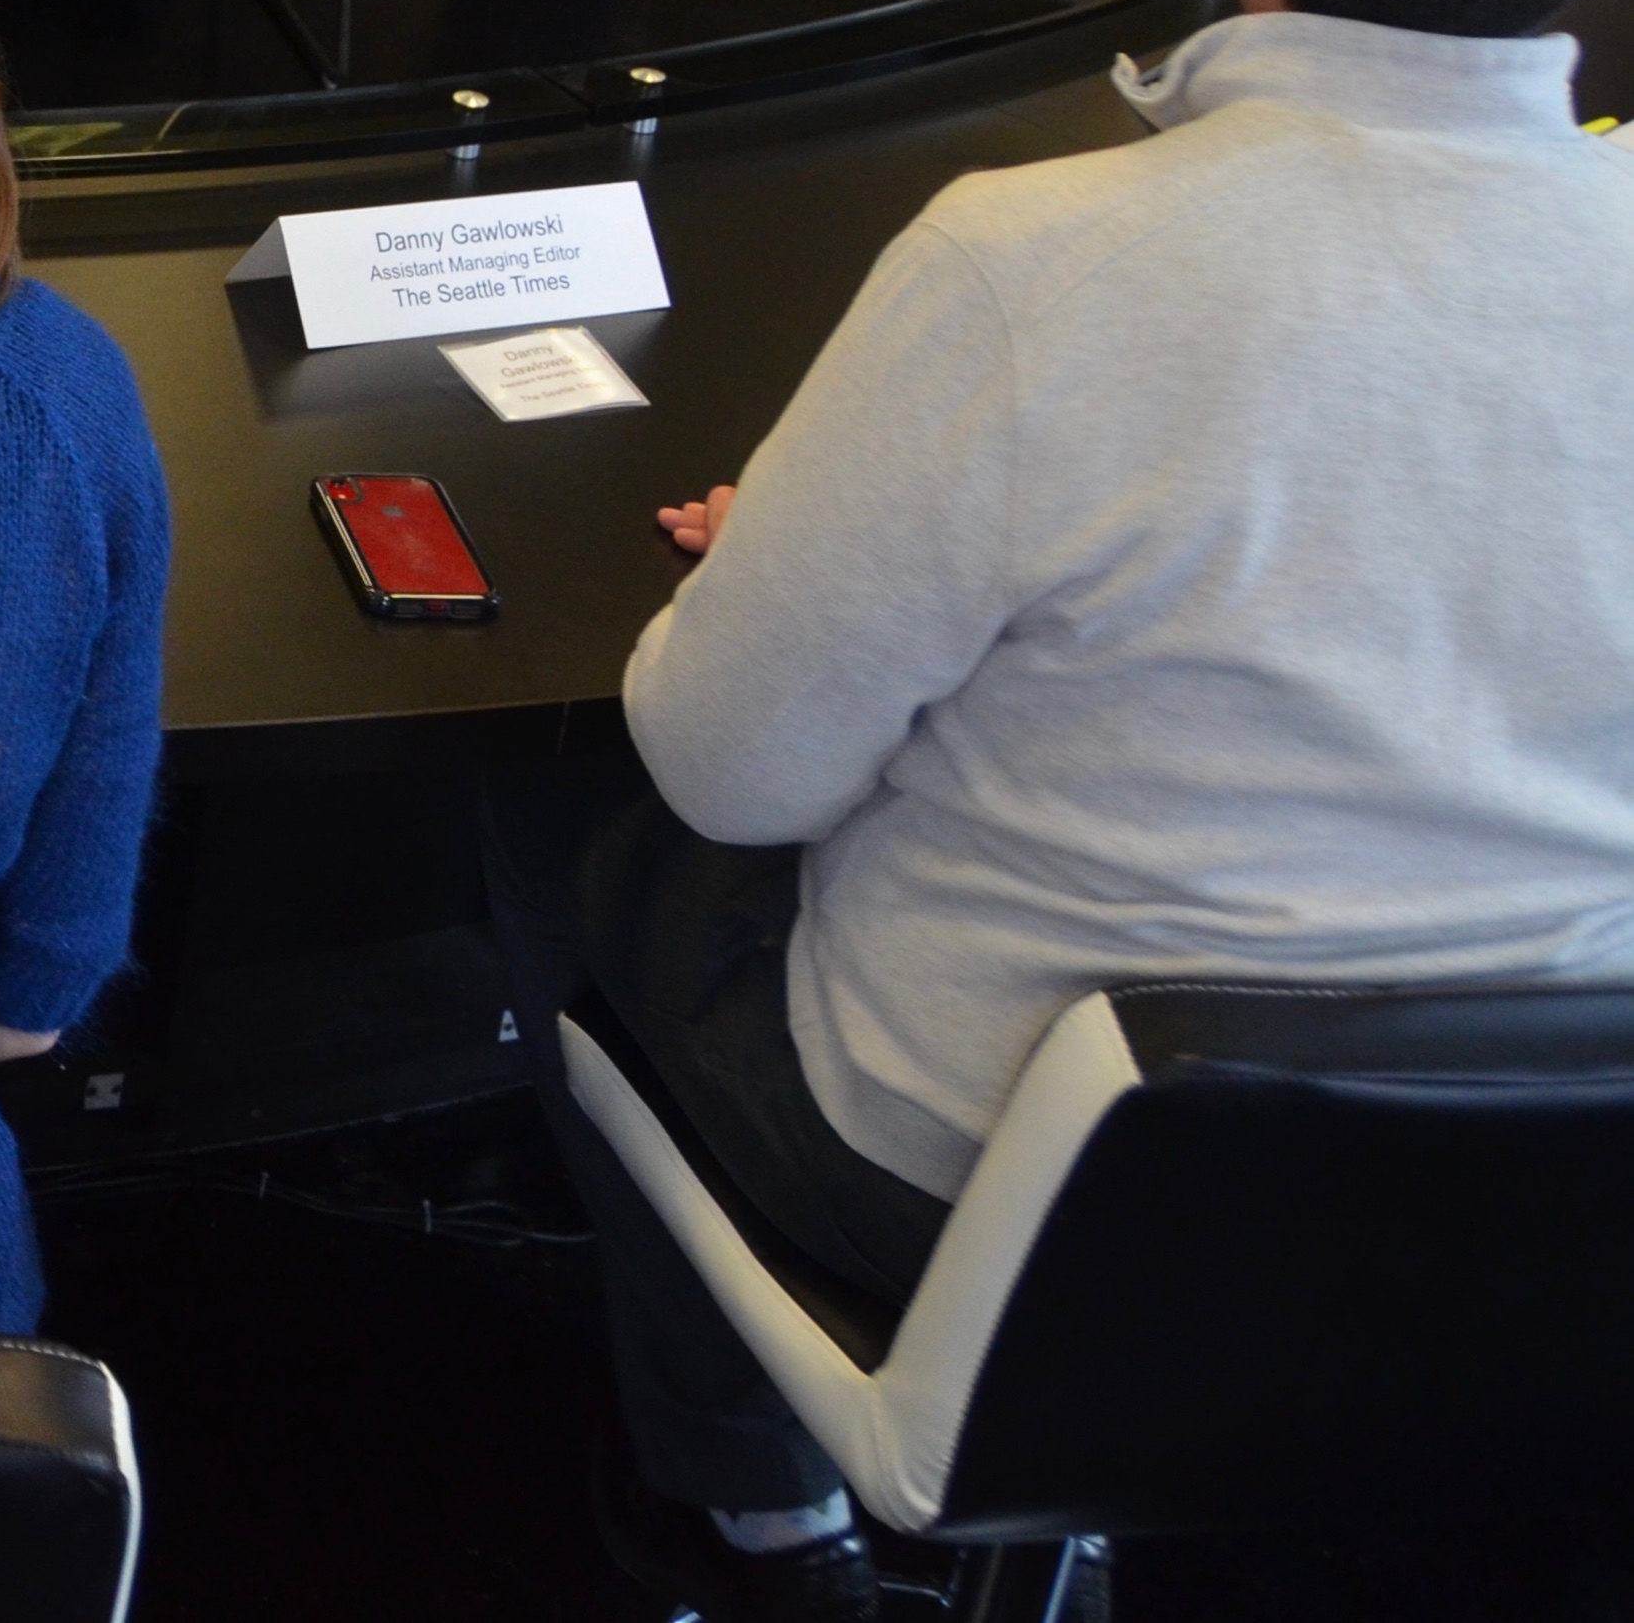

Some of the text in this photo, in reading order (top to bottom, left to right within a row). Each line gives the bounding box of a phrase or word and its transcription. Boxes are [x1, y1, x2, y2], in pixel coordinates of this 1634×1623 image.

[375, 214, 564, 253] Danny Gawlowski
[370, 245, 581, 282] Assistant Managing Editor
[392, 273, 571, 308] The Seattle Times
[500, 355, 575, 378] Gawlowsk
[503, 344, 553, 362] Danny
